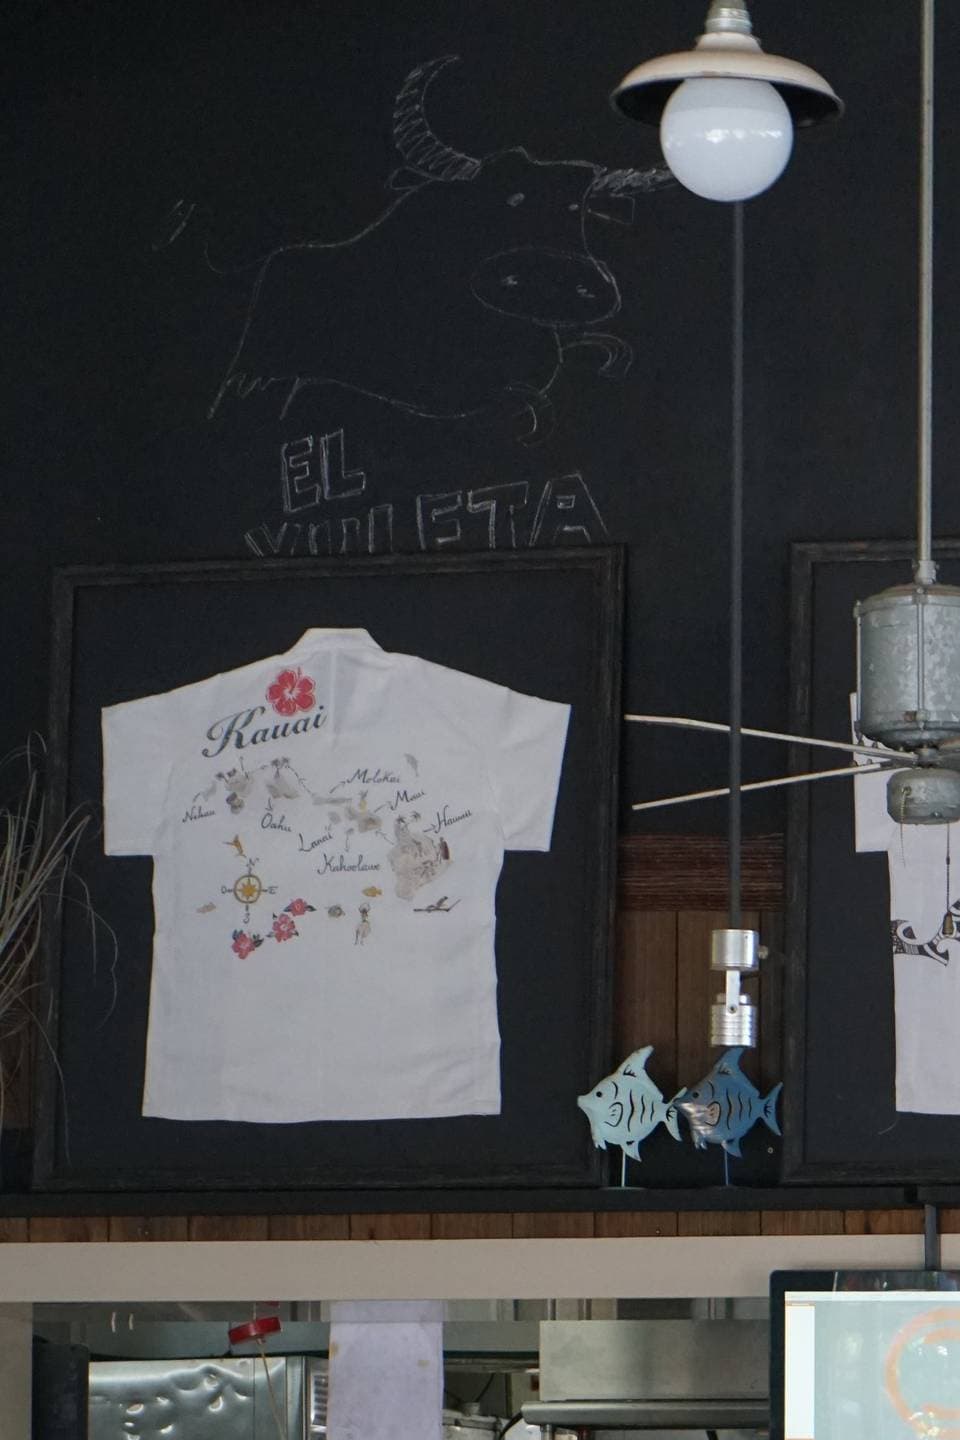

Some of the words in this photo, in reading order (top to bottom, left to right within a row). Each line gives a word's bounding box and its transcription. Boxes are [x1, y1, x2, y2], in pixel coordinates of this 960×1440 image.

[281, 428, 367, 513] EL
[201, 706, 327, 758] Kauai
[261, 812, 292, 832] Oahu
